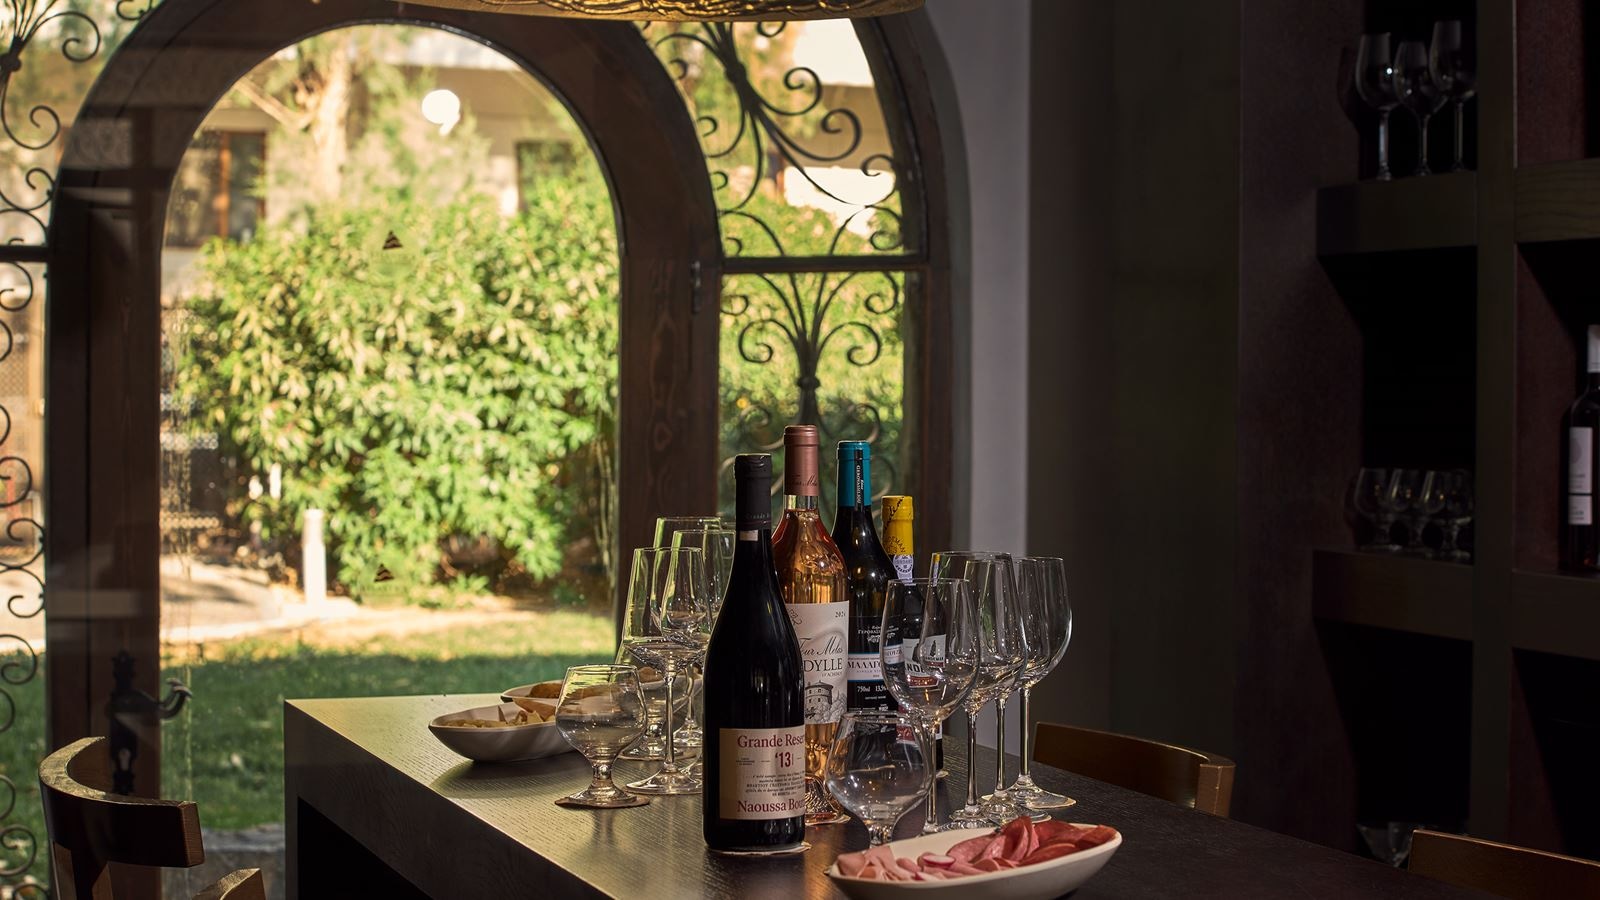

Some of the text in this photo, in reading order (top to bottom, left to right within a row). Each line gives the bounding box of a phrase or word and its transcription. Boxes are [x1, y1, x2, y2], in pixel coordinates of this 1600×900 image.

[803, 658, 843, 673] DYLLE
[737, 734, 783, 748] Grande
[737, 800, 786, 813] Naoussa
